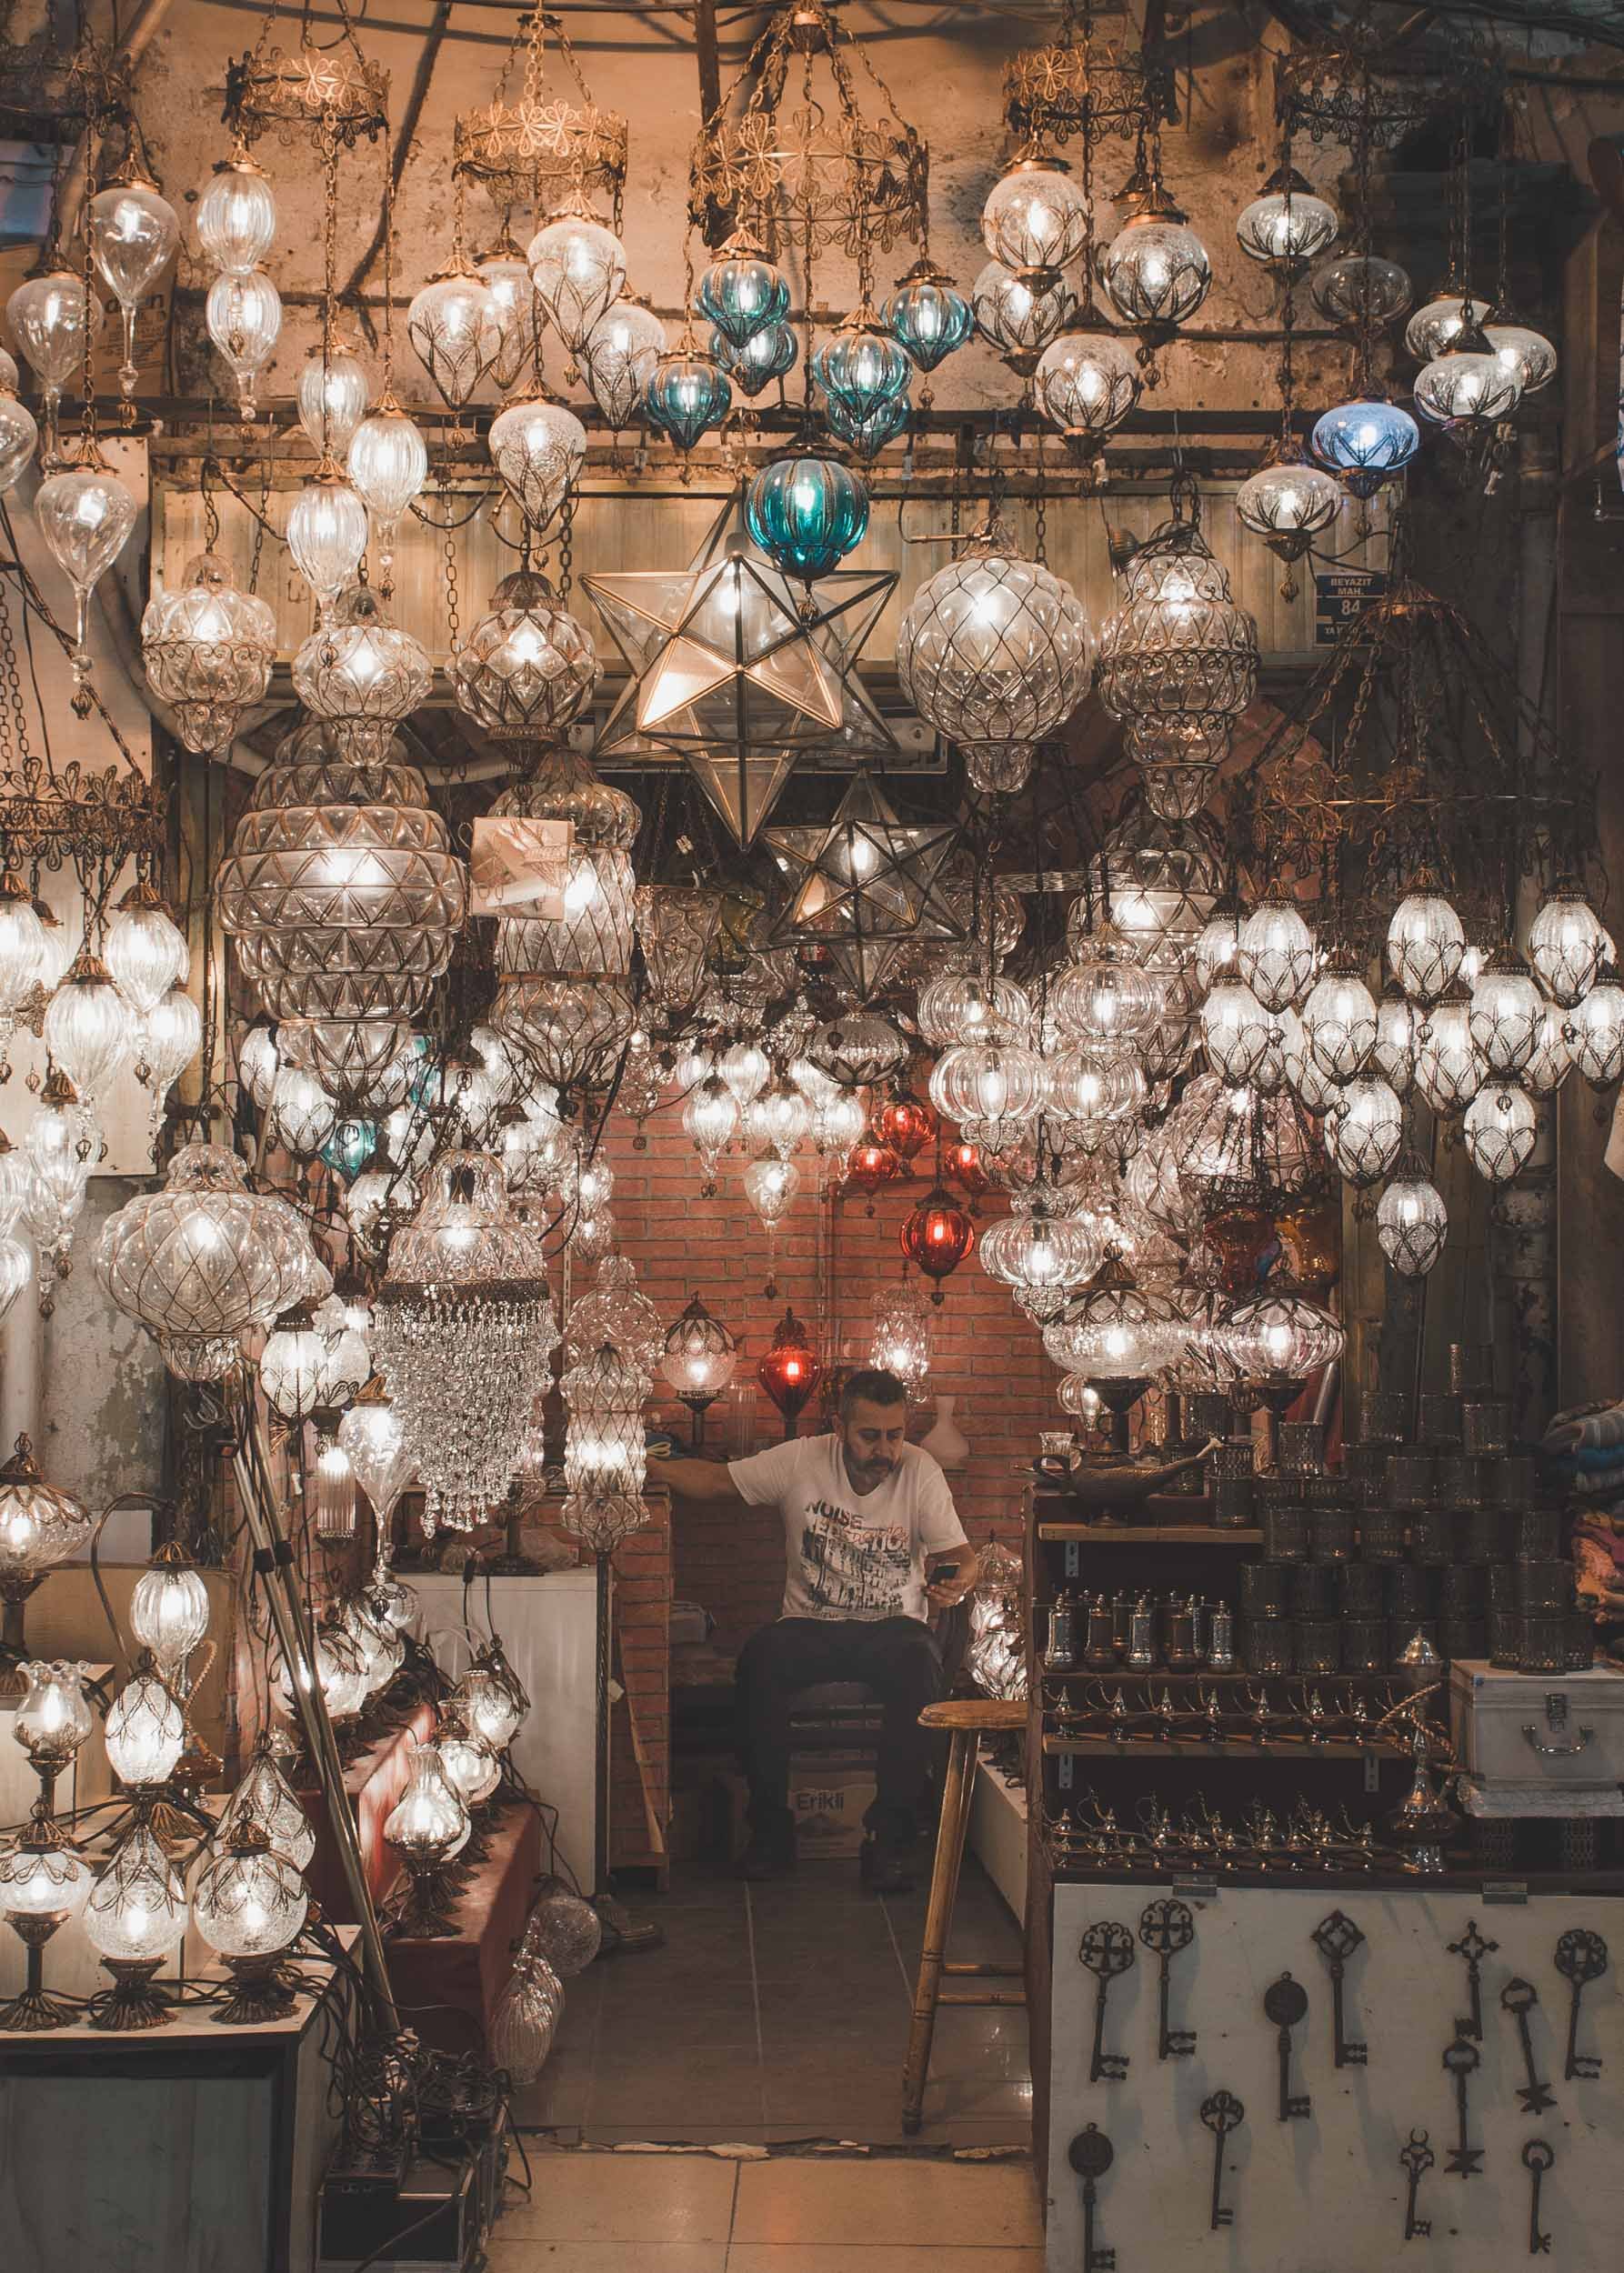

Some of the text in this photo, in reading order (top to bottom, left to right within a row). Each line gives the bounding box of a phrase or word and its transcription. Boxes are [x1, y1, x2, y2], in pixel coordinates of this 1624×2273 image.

[1330, 577, 1373, 586] BEYAZIT
[1338, 587, 1365, 596] MAH.
[1341, 599, 1360, 616] 84
[805, 1498, 865, 1530] NOISE
[797, 1791, 845, 1810] Erikli
